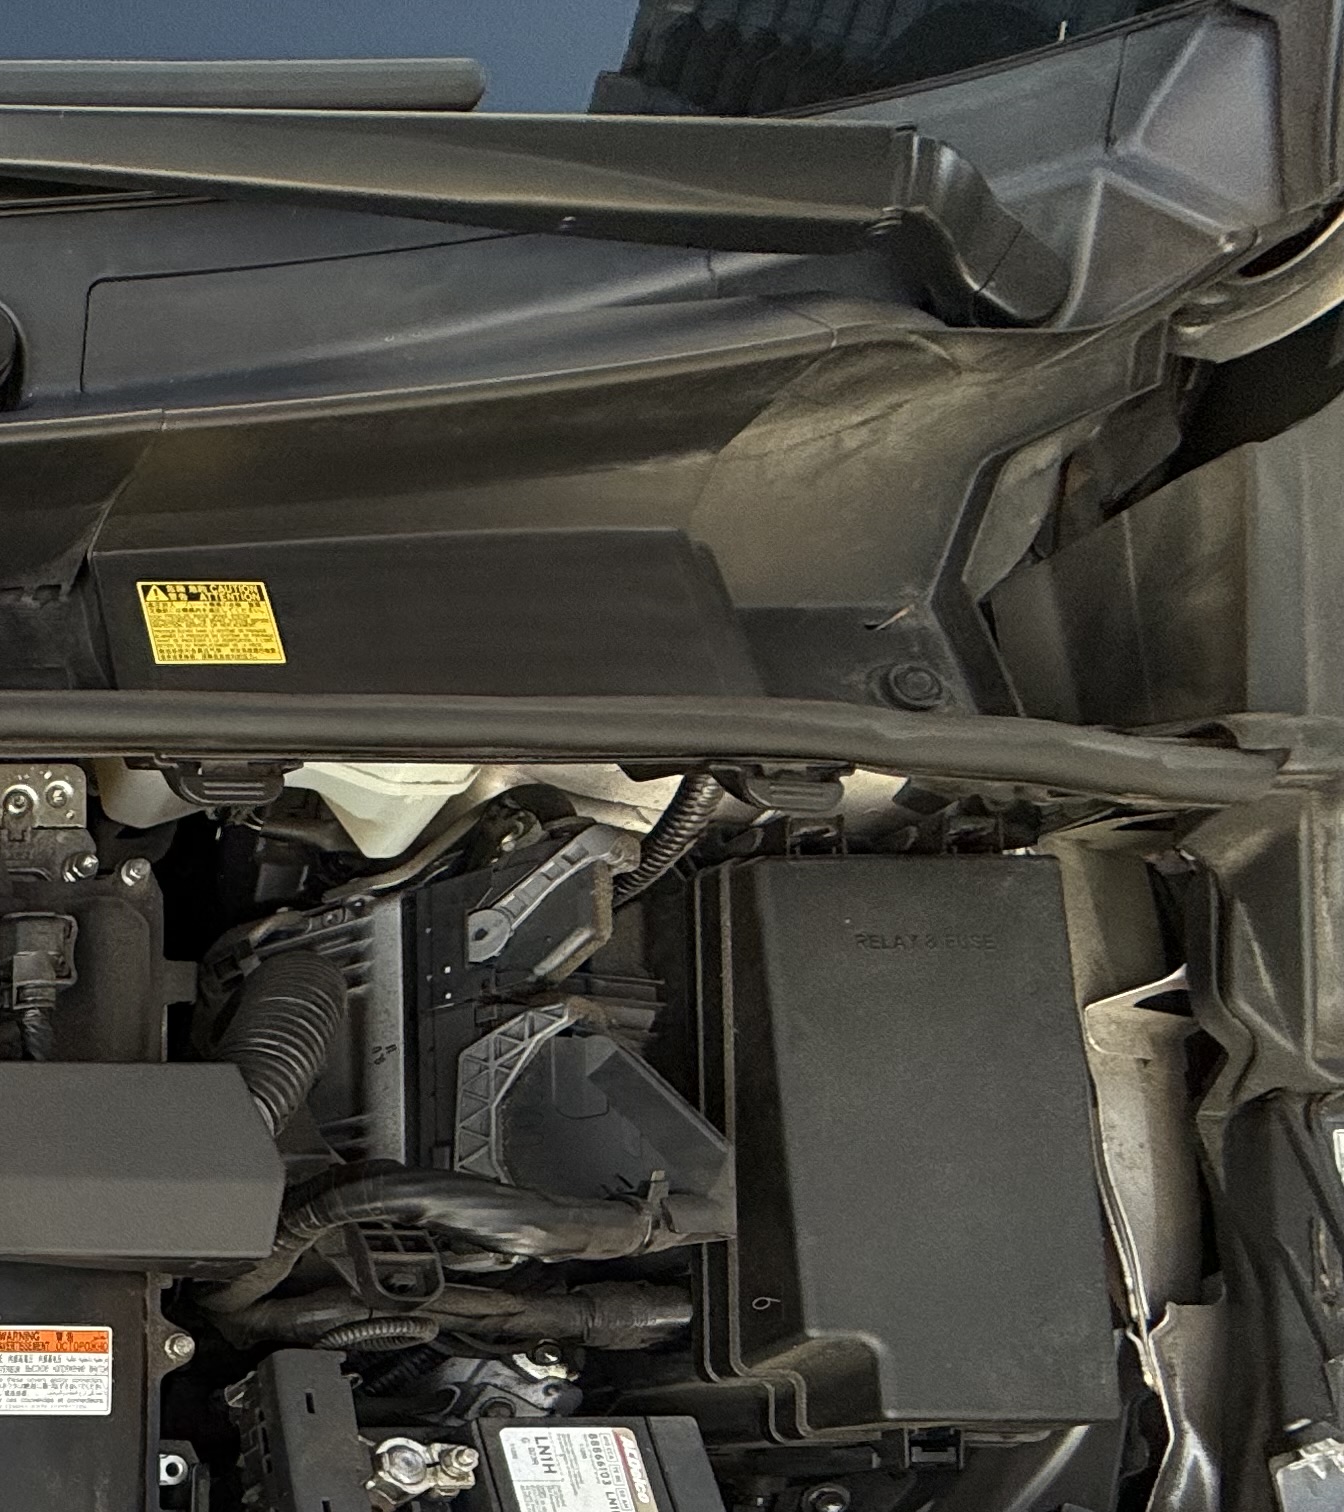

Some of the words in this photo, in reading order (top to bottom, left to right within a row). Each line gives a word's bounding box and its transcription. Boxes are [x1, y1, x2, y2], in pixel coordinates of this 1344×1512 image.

[209, 584, 257, 593] CAUTION
[855, 934, 917, 949] RELAY
[532, 1436, 558, 1474] LN1H
